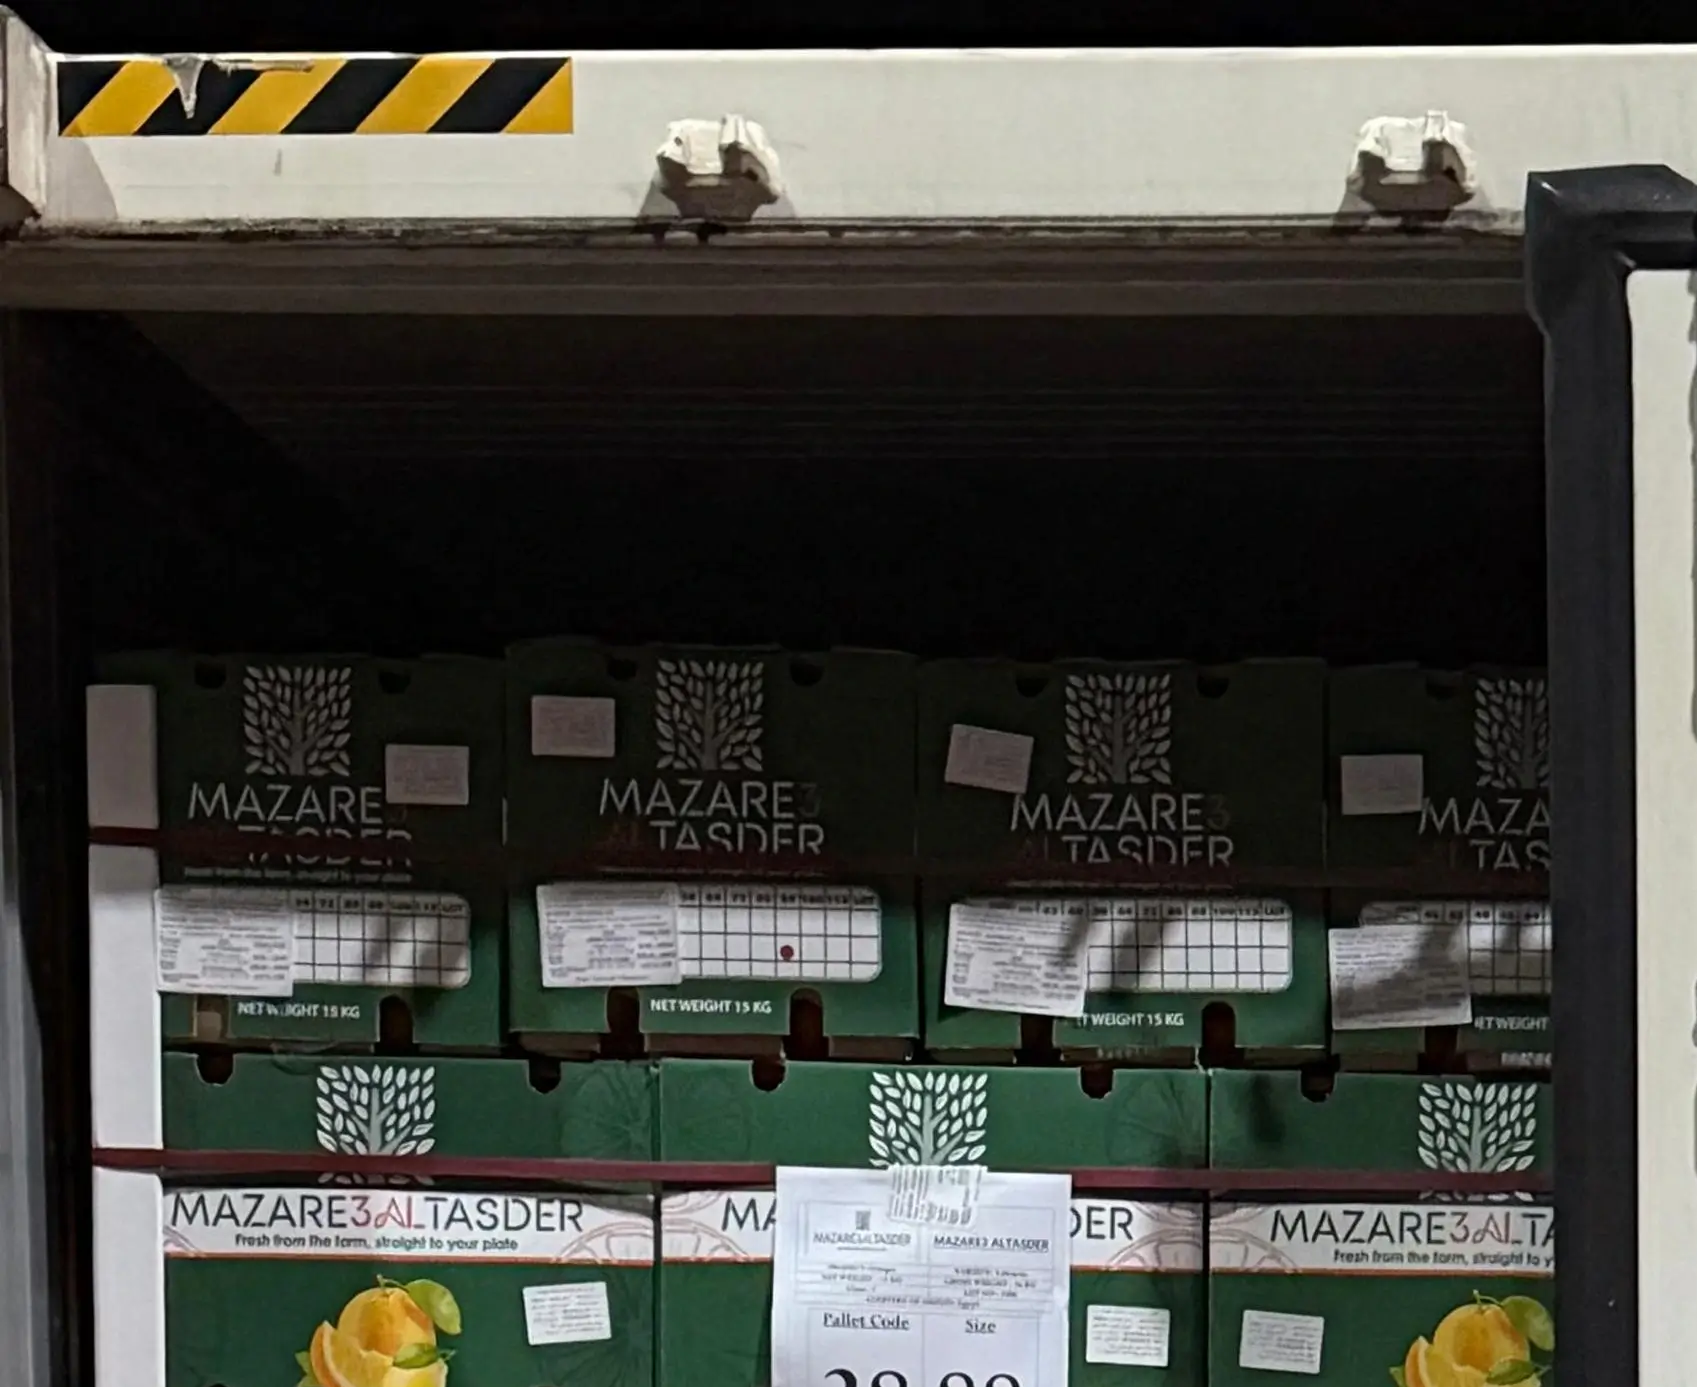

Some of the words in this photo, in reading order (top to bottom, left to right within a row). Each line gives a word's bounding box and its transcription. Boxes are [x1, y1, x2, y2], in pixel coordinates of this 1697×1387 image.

[823, 1312, 868, 1330] Pallet
[870, 1315, 910, 1332] Code
[965, 1318, 997, 1334] Size
